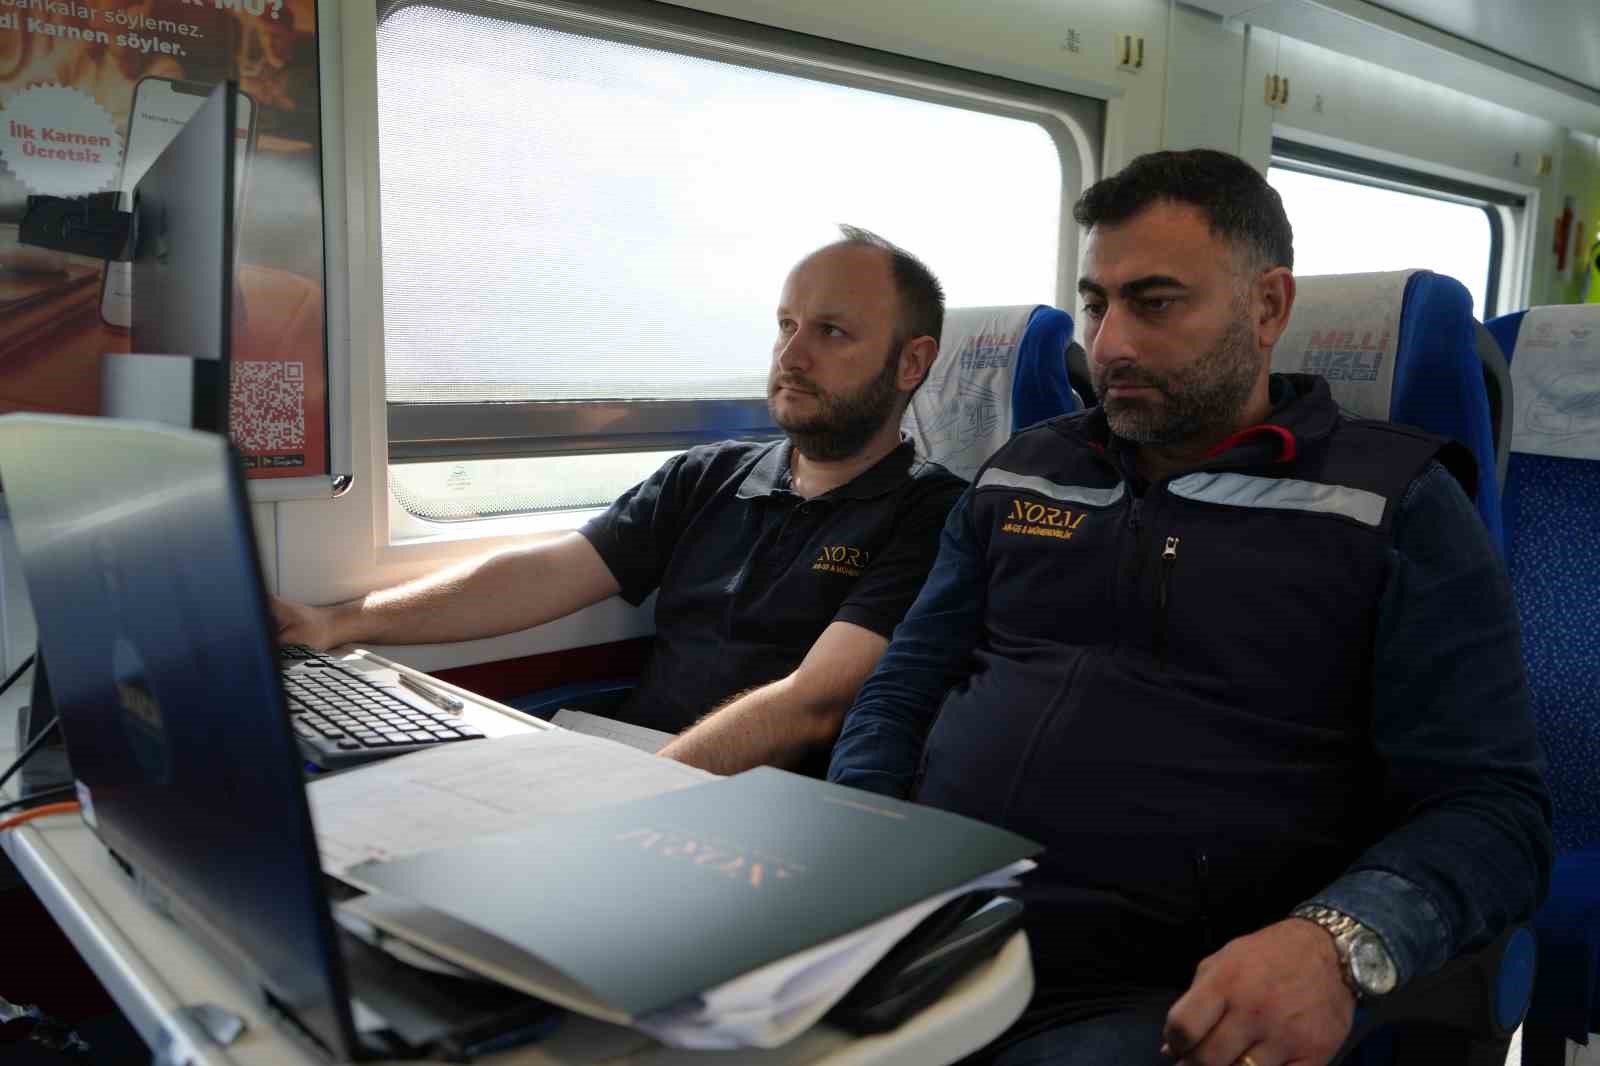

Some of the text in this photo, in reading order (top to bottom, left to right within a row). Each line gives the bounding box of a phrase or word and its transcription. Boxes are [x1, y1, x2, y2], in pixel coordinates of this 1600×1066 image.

[27, 16, 109, 45] Karnen
[115, 31, 188, 56] söyler.
[104, 8, 204, 38] söylemez.
[41, 127, 112, 147] Karnen
[22, 140, 102, 163] Ücretsiz
